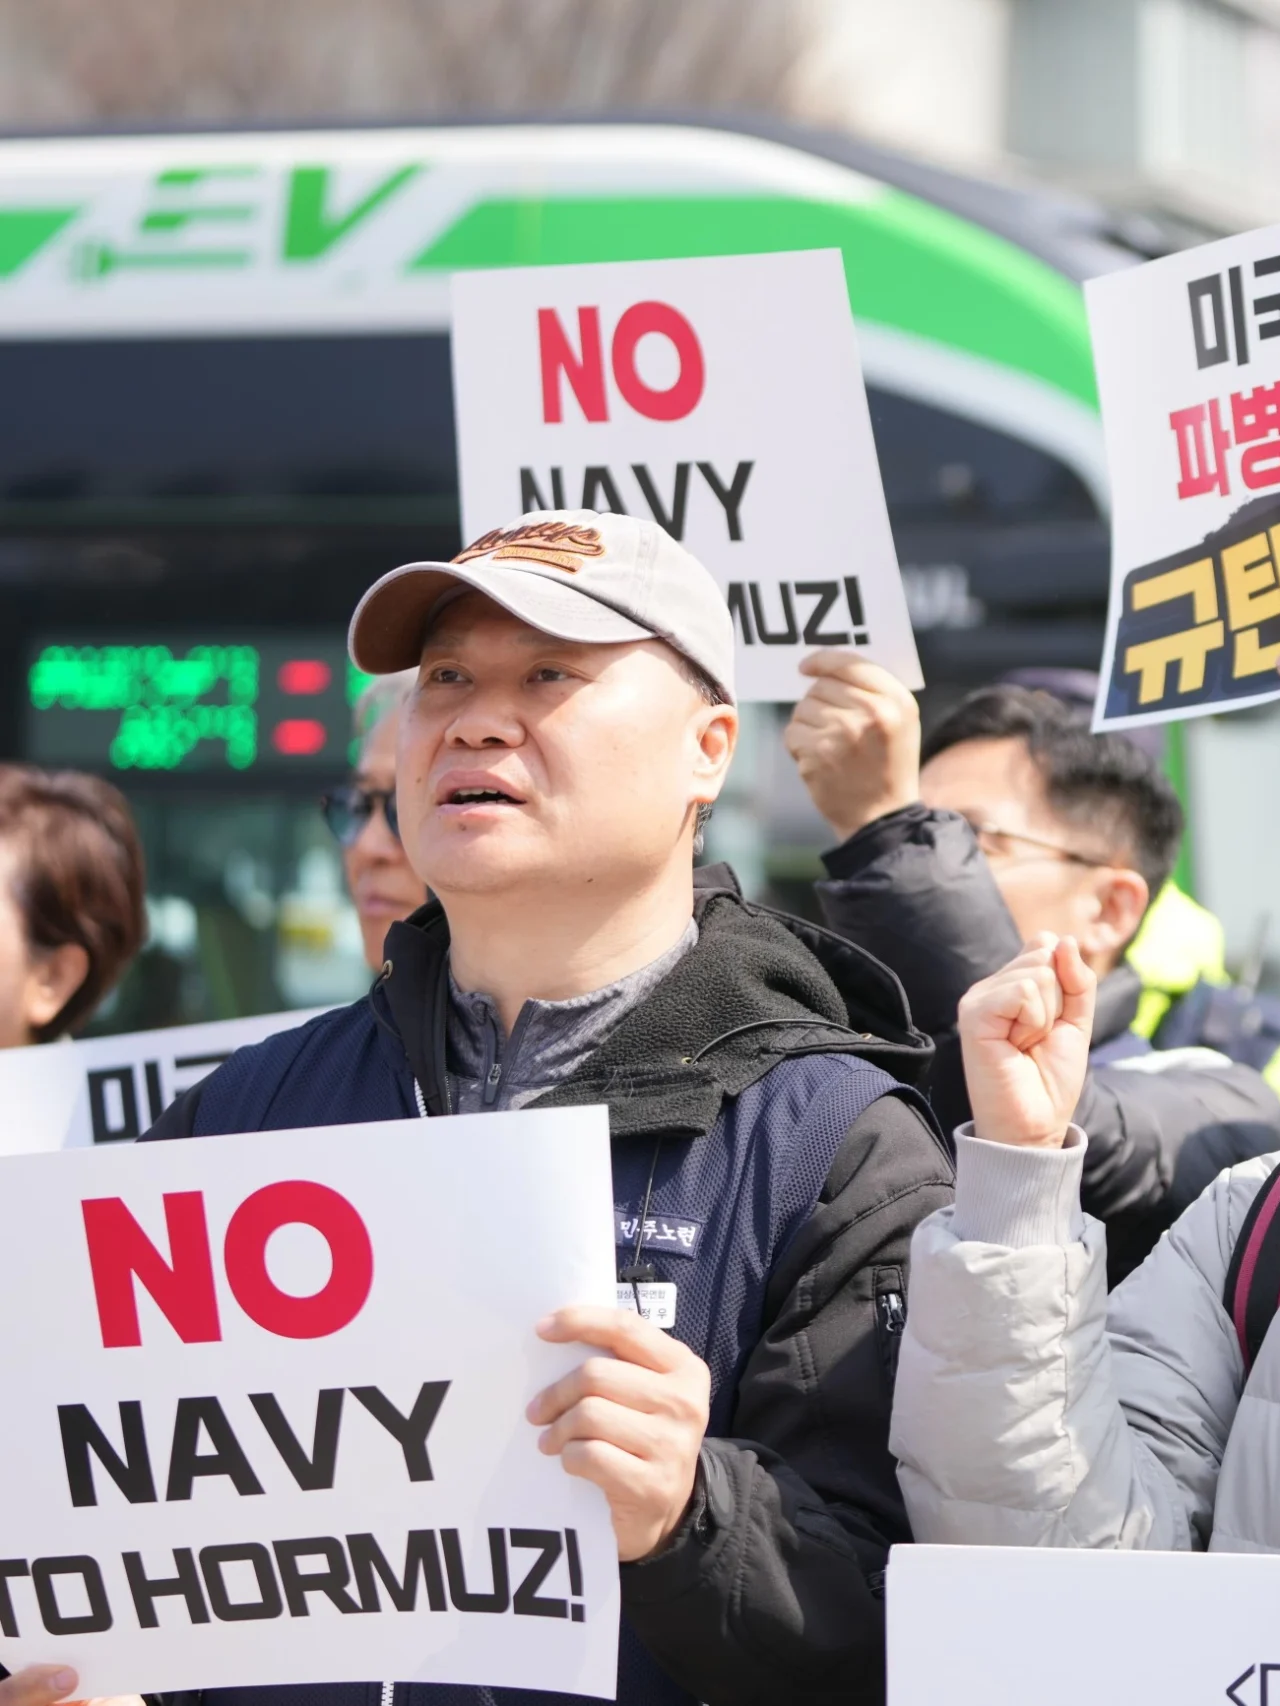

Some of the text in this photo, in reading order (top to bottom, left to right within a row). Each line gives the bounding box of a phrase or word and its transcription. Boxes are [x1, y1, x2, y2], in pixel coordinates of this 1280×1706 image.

[96, 162, 420, 272] EV
[537, 300, 705, 424] NO
[519, 461, 754, 542] NAVY
[81, 1179, 374, 1349] NO
[620, 1219, 696, 1247] 민주노련
[56, 1380, 451, 1508] NAVY
[121, 1527, 587, 1629] HORMUZ!
